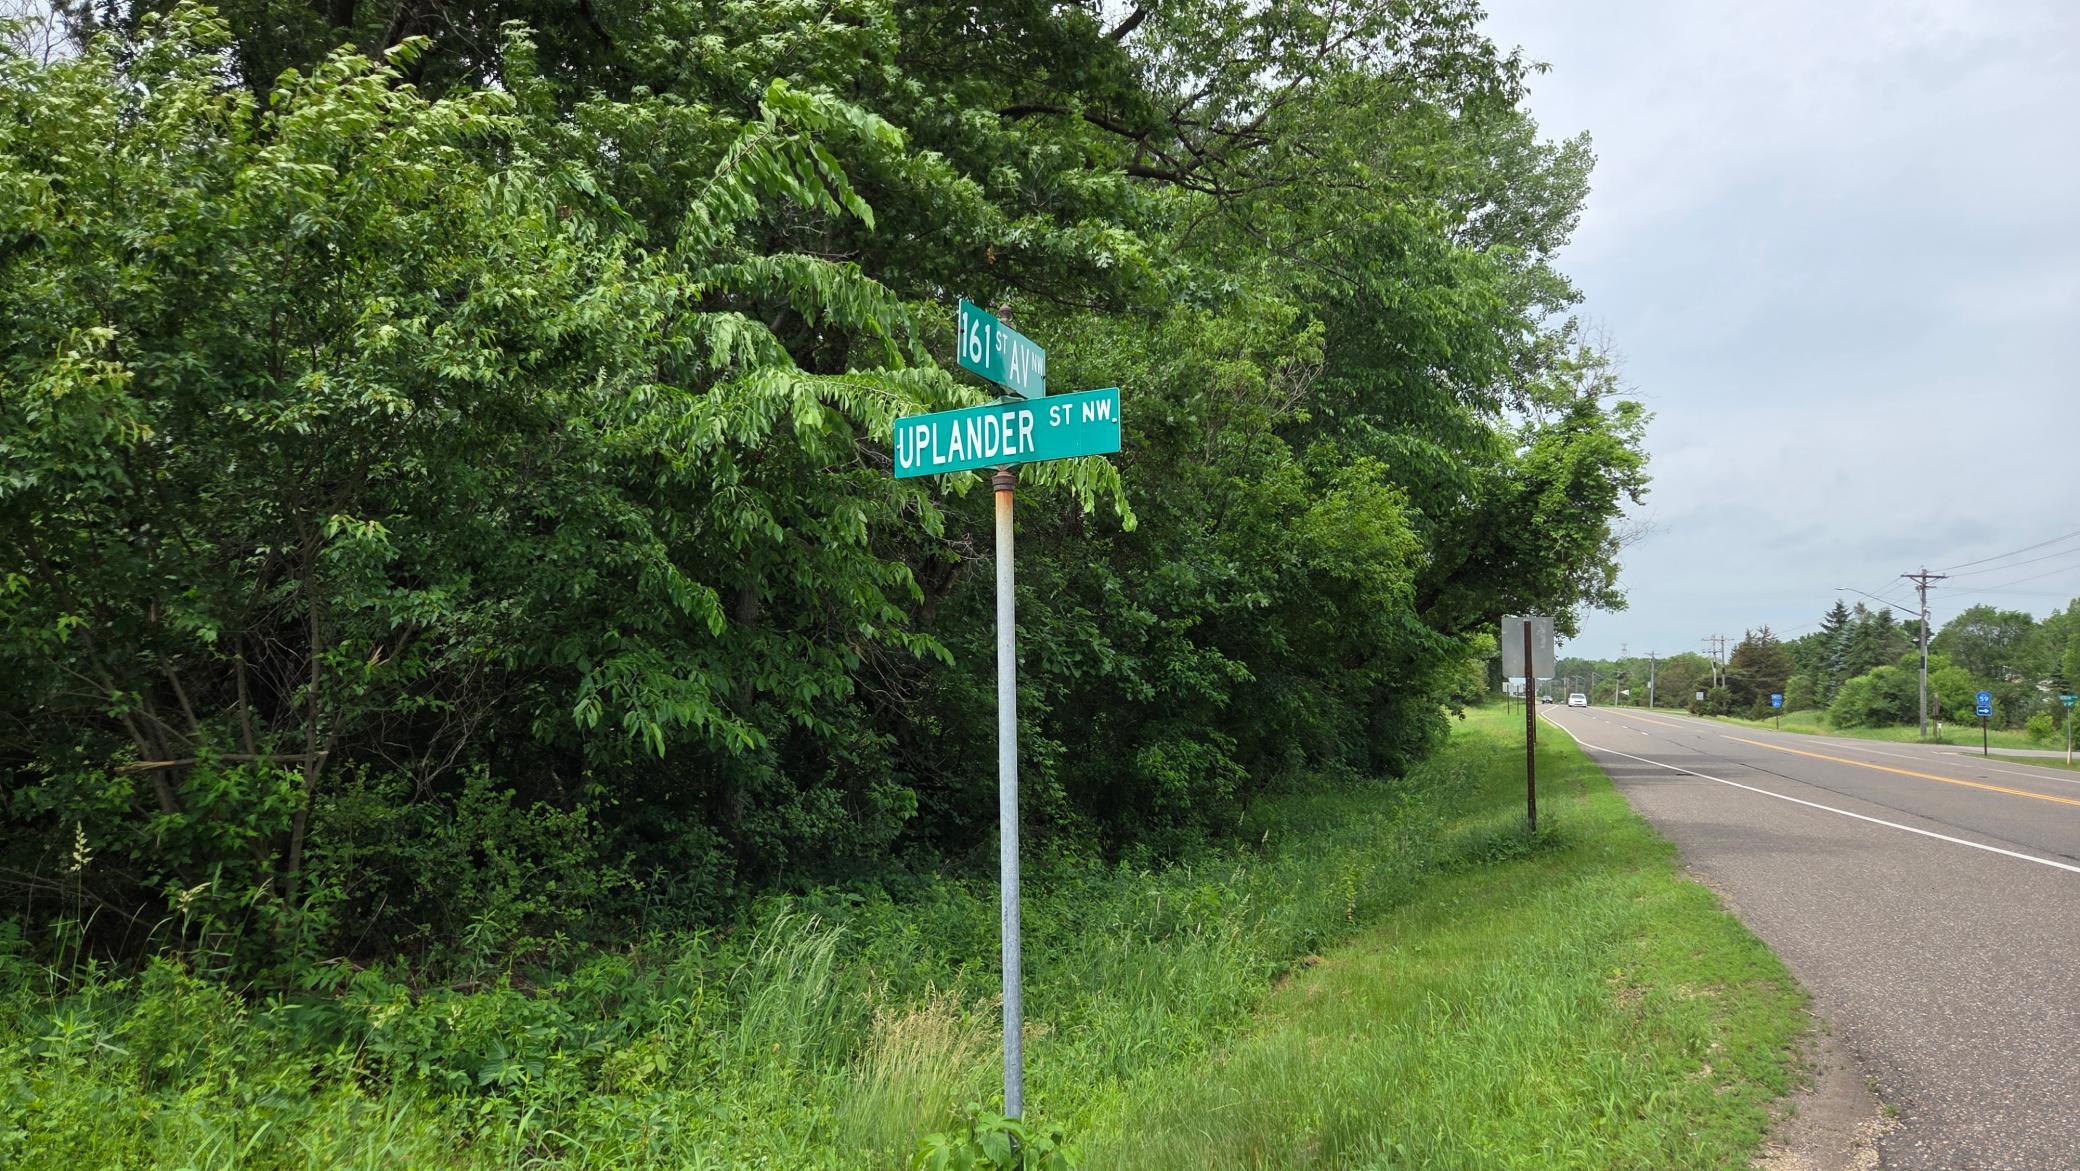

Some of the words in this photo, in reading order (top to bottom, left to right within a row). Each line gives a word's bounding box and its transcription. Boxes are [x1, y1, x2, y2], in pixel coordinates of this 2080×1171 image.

[1009, 340, 1030, 388] AV
[1031, 351, 1044, 376] NW
[899, 409, 1035, 469] UPLANDER
[1050, 403, 1073, 427] ST
